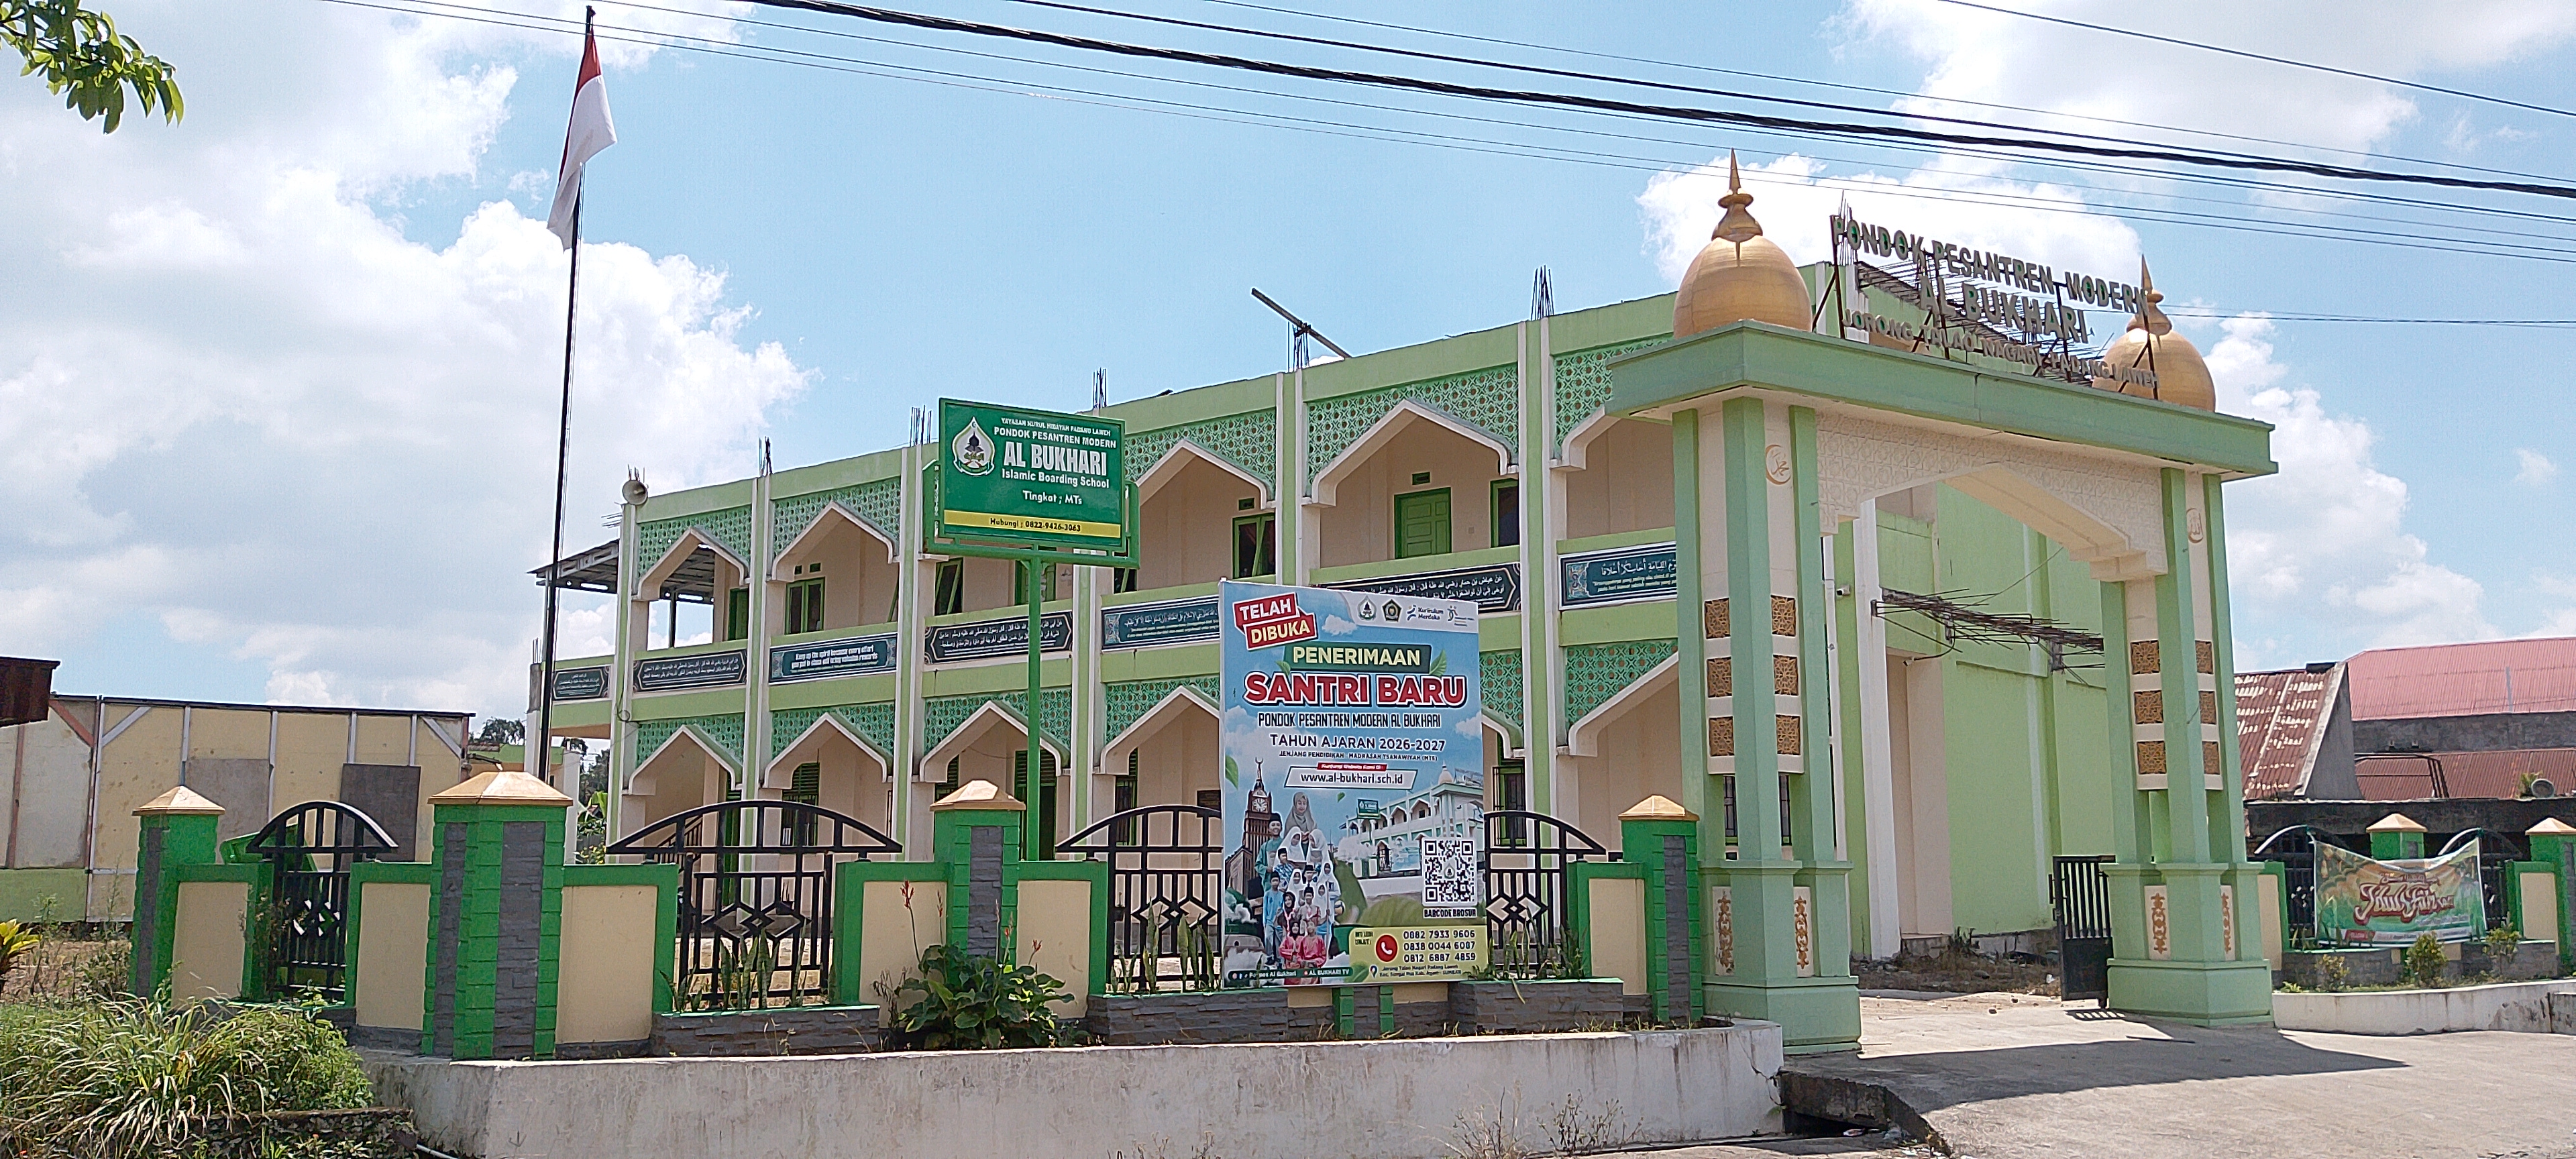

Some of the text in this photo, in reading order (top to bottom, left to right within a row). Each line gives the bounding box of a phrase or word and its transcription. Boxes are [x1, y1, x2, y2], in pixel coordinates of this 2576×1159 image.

[1833, 217, 2149, 316] PONDOK PESANTREN MODERN
[1919, 275, 2088, 344] AL BUKHARI
[1842, 309, 1913, 341] JORONG
[1922, 324, 1975, 353] TALAO
[1982, 337, 2045, 368] NAGARI
[2050, 351, 2109, 380] PADANG
[1001, 418, 1026, 427] YAYASAN
[994, 427, 1116, 449] PONDOK PESANTREN MODERN
[1004, 441, 1107, 476] AL BUKHARI
[1002, 468, 1110, 488] Islamic Boarding School
[1022, 490, 1057, 504] Tingkat
[1065, 494, 1082, 504] MTs
[990, 518, 1019, 528] Hubungi
[1239, 598, 1291, 620] TELAH
[1250, 619, 1310, 644] DIBUKA
[1293, 647, 1421, 666] PENERIMAAN
[1245, 673, 1465, 706] SANTRI BARU
[1258, 713, 1441, 728] PONDOK PESANTREN MODERN AL BUKHARI
[1271, 734, 1445, 751] TAHUN AJARAN 2026-2027
[1301, 771, 1403, 784] www.al-bukhari.sch.id
[1424, 908, 1476, 918] BARCODE BROSUR
[1403, 930, 1475, 939] 0882 7933 9606
[1403, 942, 1425, 950] 0838
[1428, 942, 1451, 950] 0044
[1404, 954, 1424, 962] 0812
[1454, 952, 1476, 961] 4859
